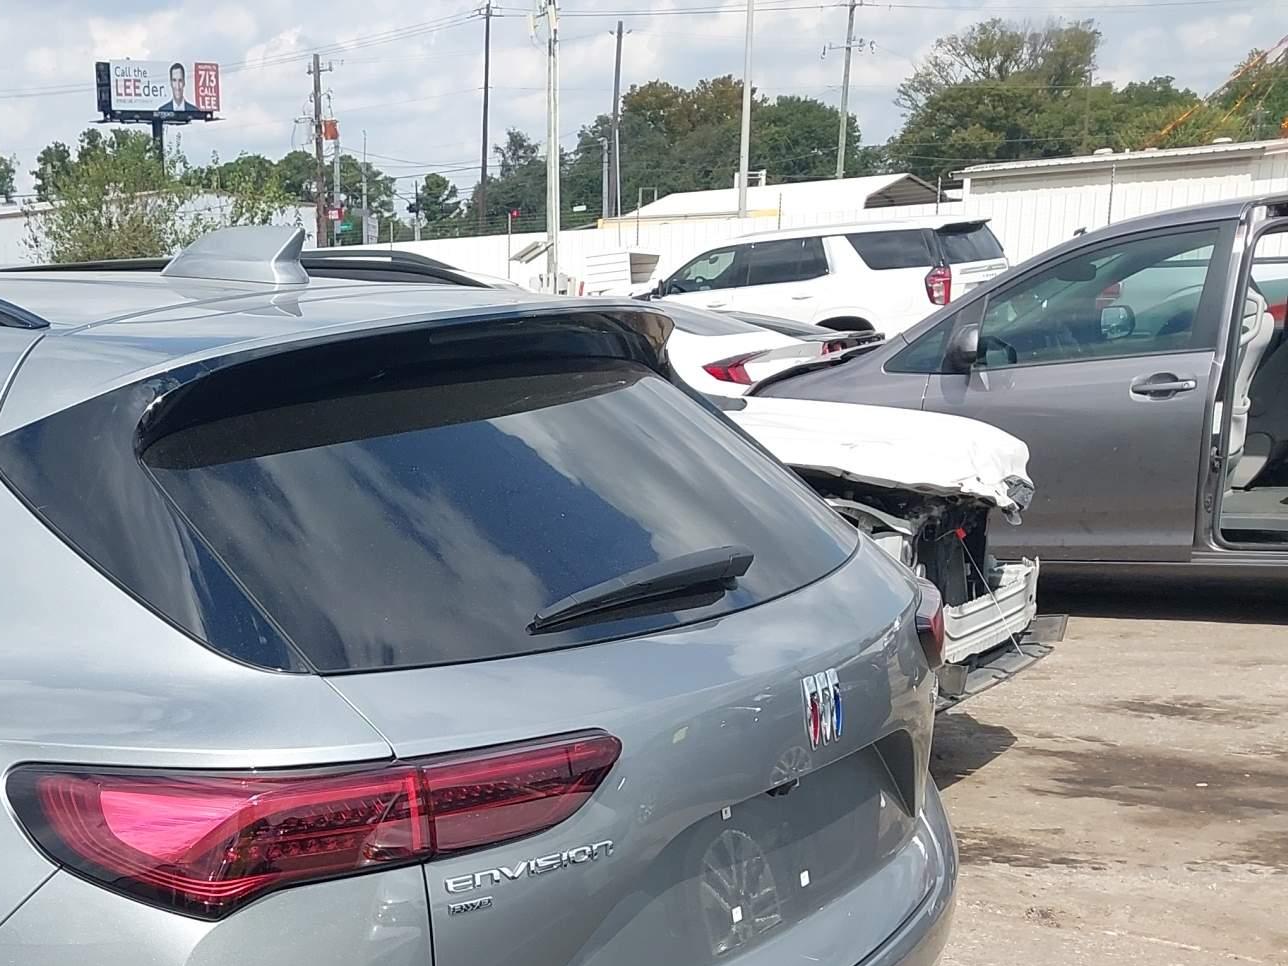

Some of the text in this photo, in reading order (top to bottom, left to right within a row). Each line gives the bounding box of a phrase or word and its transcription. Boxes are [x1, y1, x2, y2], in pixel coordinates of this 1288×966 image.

[114, 66, 148, 78] Call the
[198, 71, 217, 87] 713
[199, 87, 217, 97] CALL
[199, 97, 218, 110] LEE
